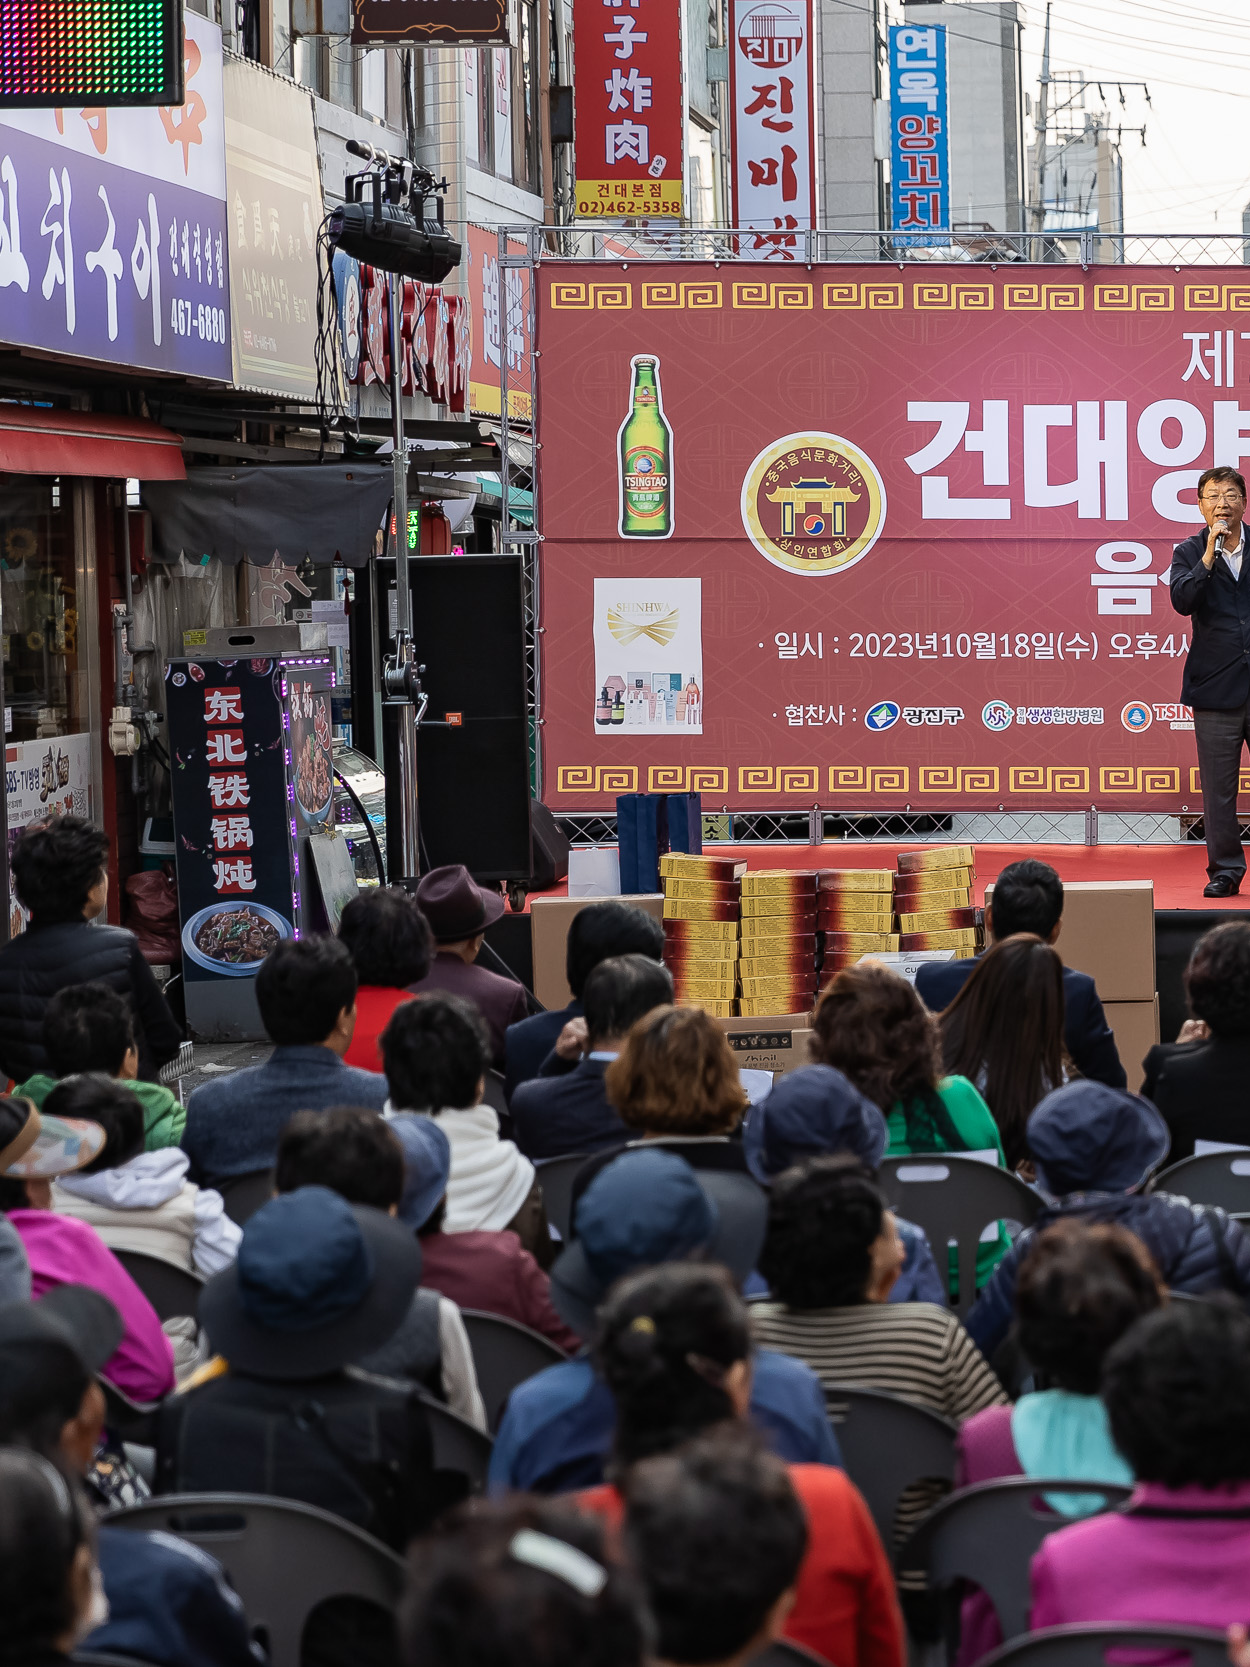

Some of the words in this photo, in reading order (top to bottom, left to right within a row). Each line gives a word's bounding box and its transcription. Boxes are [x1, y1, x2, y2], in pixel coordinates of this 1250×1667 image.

[746, 38, 796, 63] 진미
[603, 0, 652, 166] 子炸肉
[899, 116, 941, 227] 양꼬치
[597, 183, 663, 198] 건대본점
[579, 201, 680, 214] 02)462-5358
[171, 298, 226, 344] 467-6880
[765, 449, 862, 485] 중국음식문화거리
[625, 476, 668, 488] TSINGTAO
[780, 538, 847, 559] 상인연합회
[616, 602, 671, 613] SHINHWA
[774, 632, 824, 660] 일시
[849, 631, 1099, 660] 2023년10월18일(수)
[785, 704, 845, 727] 협찬사
[903, 707, 965, 725] 광진구
[1027, 708, 1103, 723] 생생한방병원
[203, 690, 257, 892] 东北铁锅炖
